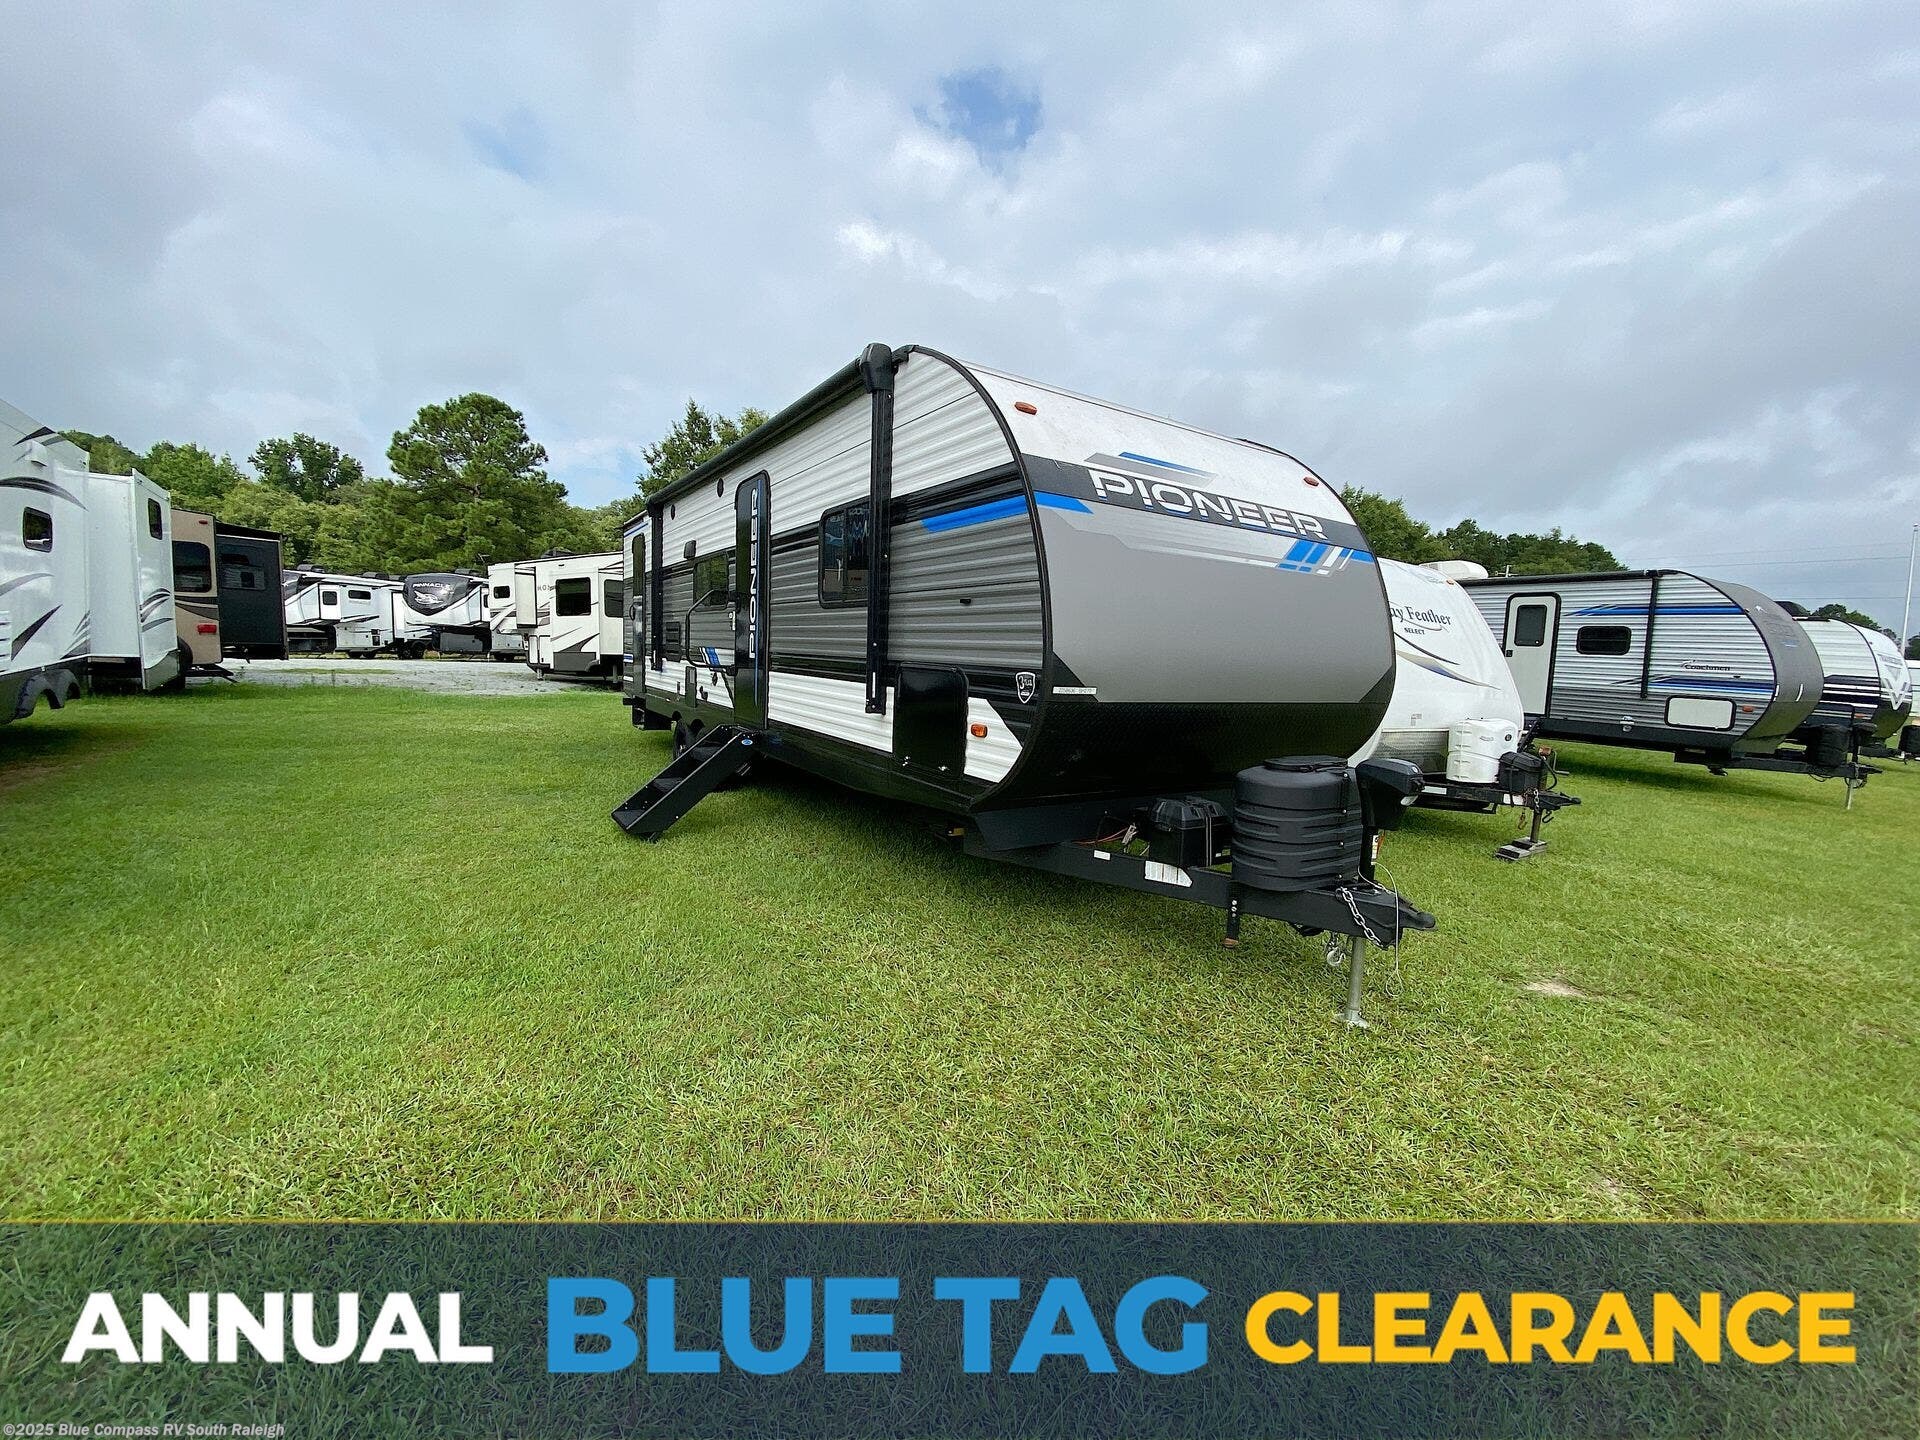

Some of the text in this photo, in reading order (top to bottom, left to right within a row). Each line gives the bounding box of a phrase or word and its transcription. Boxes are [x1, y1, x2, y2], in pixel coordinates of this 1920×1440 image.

[1087, 469, 1329, 541] PIONEER
[749, 488, 758, 659] PIONEER
[1389, 606, 1451, 625] ay Feather
[1404, 627, 1425, 635] SELECT
[1682, 661, 1731, 671] Coachmen
